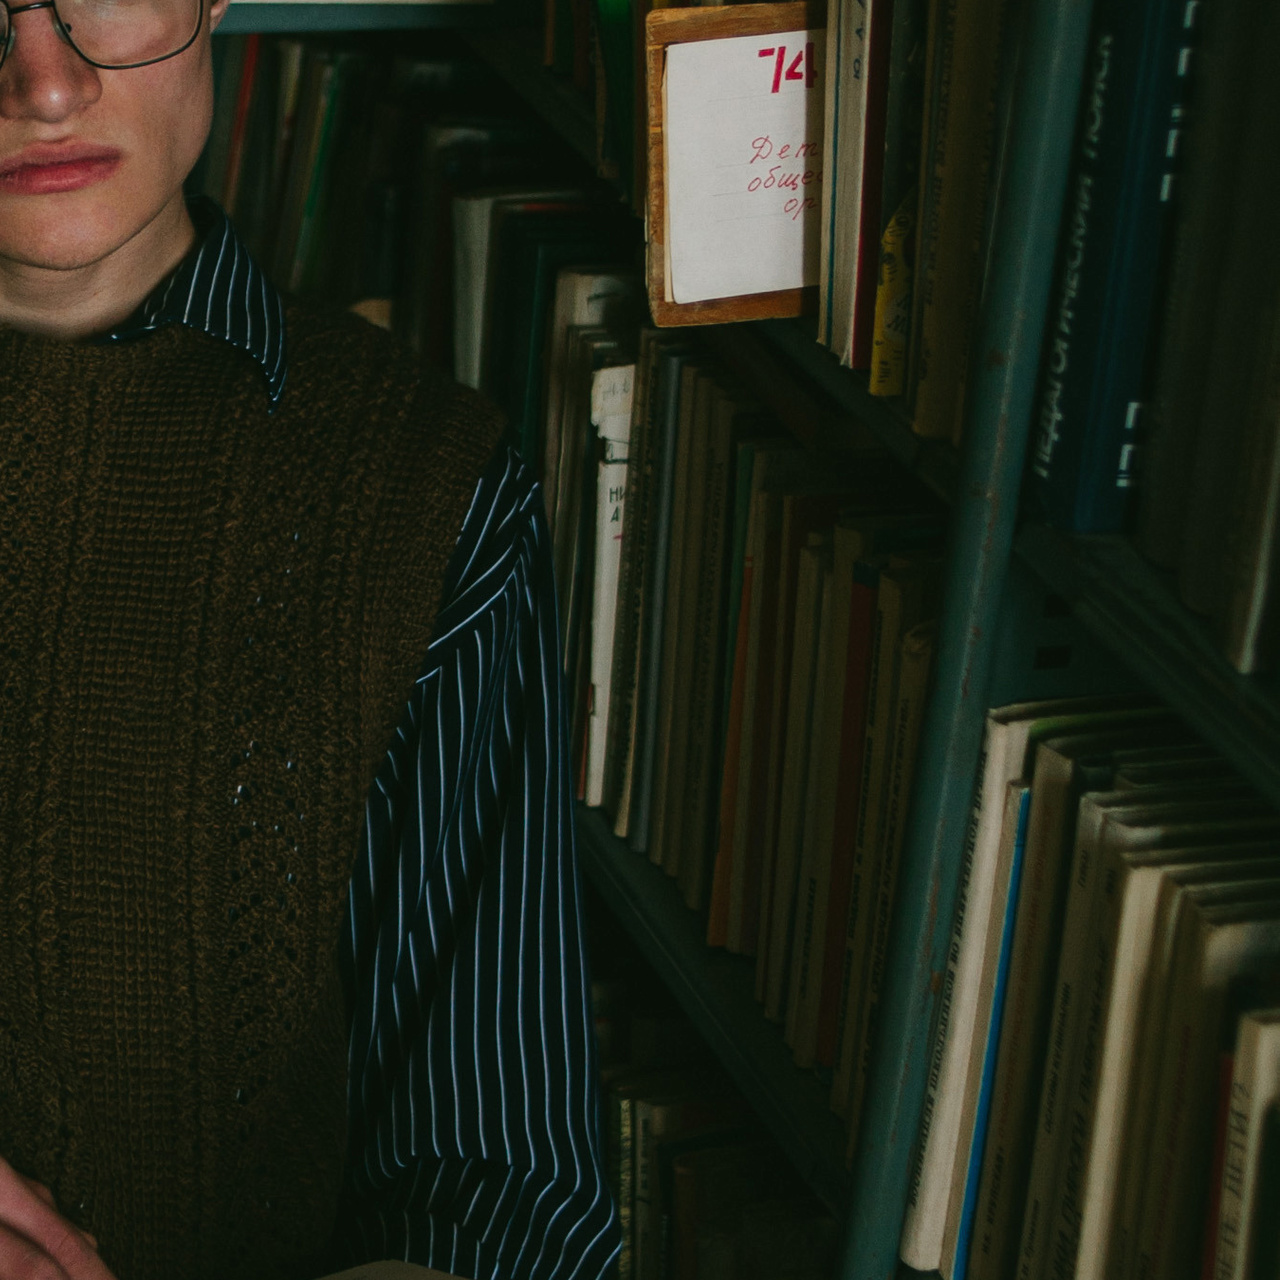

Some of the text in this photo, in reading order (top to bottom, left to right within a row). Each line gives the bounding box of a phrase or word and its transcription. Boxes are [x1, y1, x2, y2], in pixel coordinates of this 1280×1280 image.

[758, 42, 818, 93] 74
[1032, 32, 1114, 479] ПЕДАГОГИЧЕСКИЙ ПОИСК
[908, 1093, 934, 1207] ВОСПИТАНИЕ
[928, 969, 954, 1088] ШКОЛЬНИКОВ
